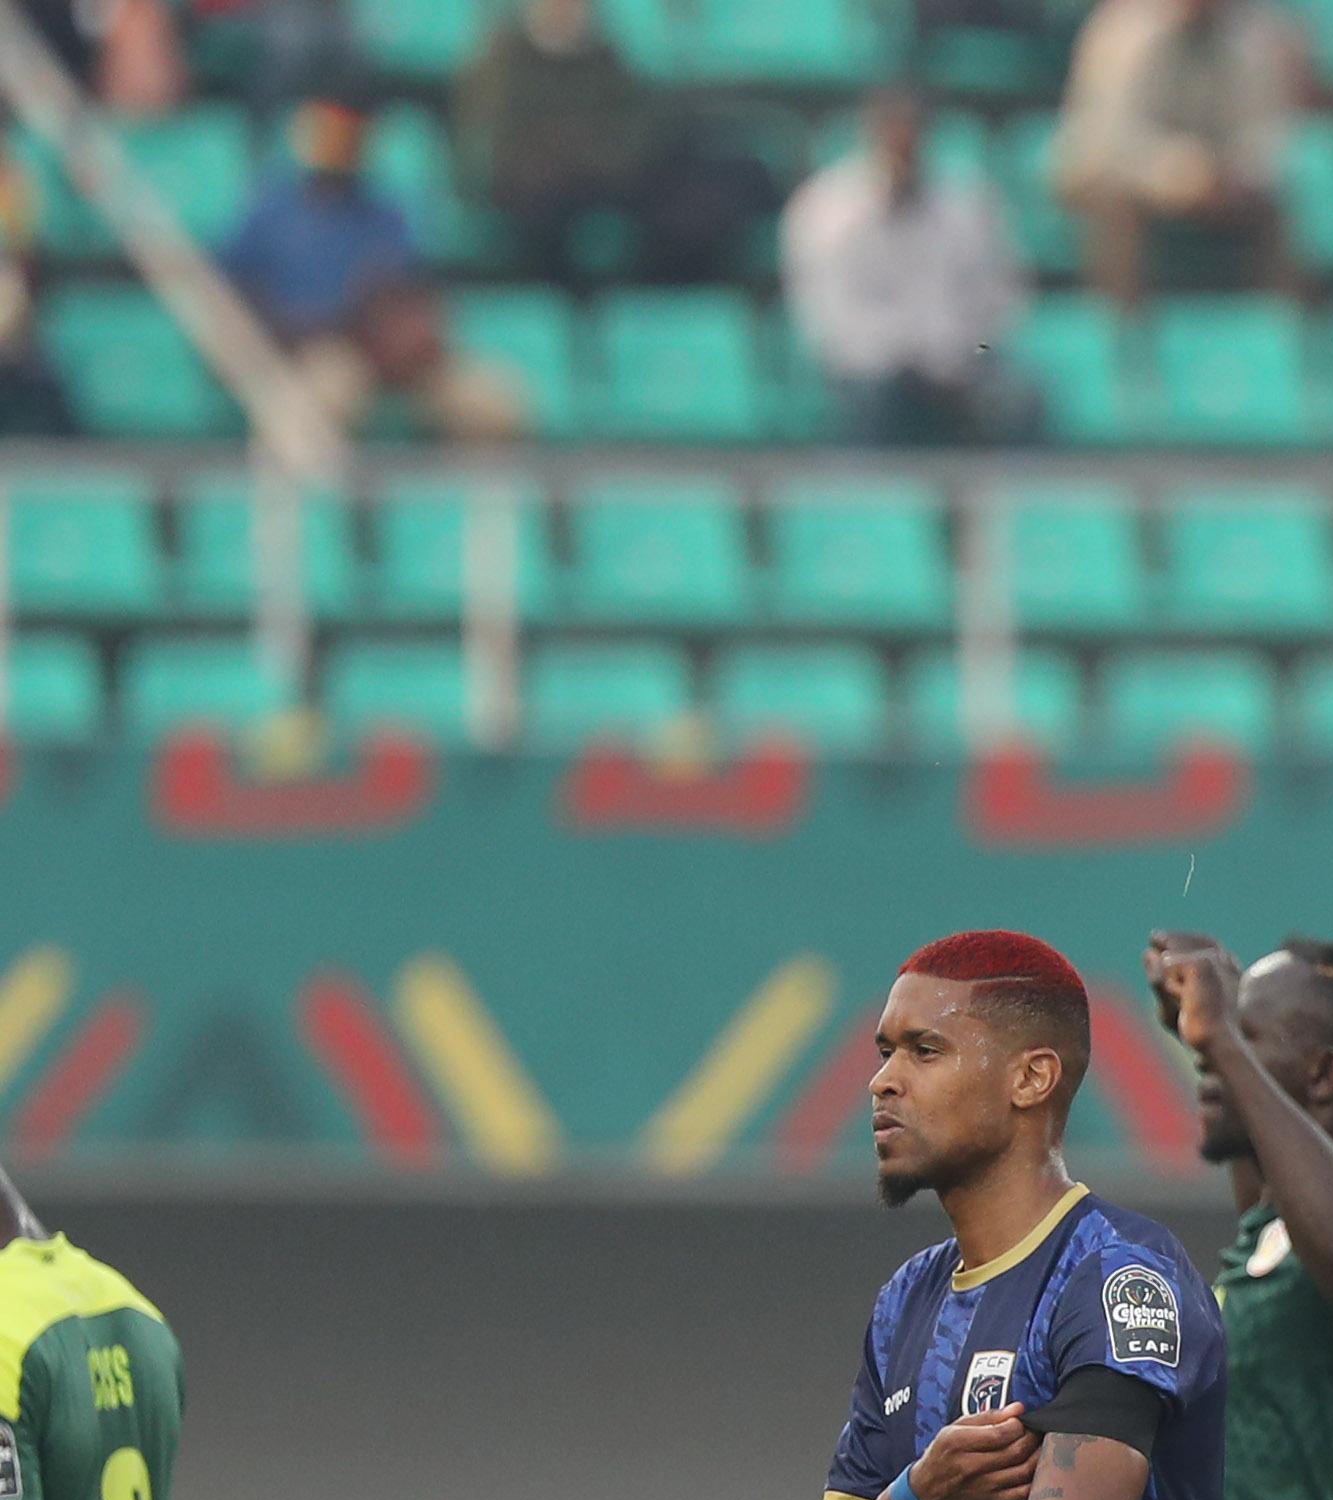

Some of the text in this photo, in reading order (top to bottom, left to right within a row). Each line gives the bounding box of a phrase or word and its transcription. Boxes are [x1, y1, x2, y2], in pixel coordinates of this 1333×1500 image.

[1112, 1303, 1175, 1323] Celebrate
[1126, 1315, 1166, 1330] Africa
[1129, 1340, 1169, 1354] CAF
[975, 1356, 1009, 1369] FCF
